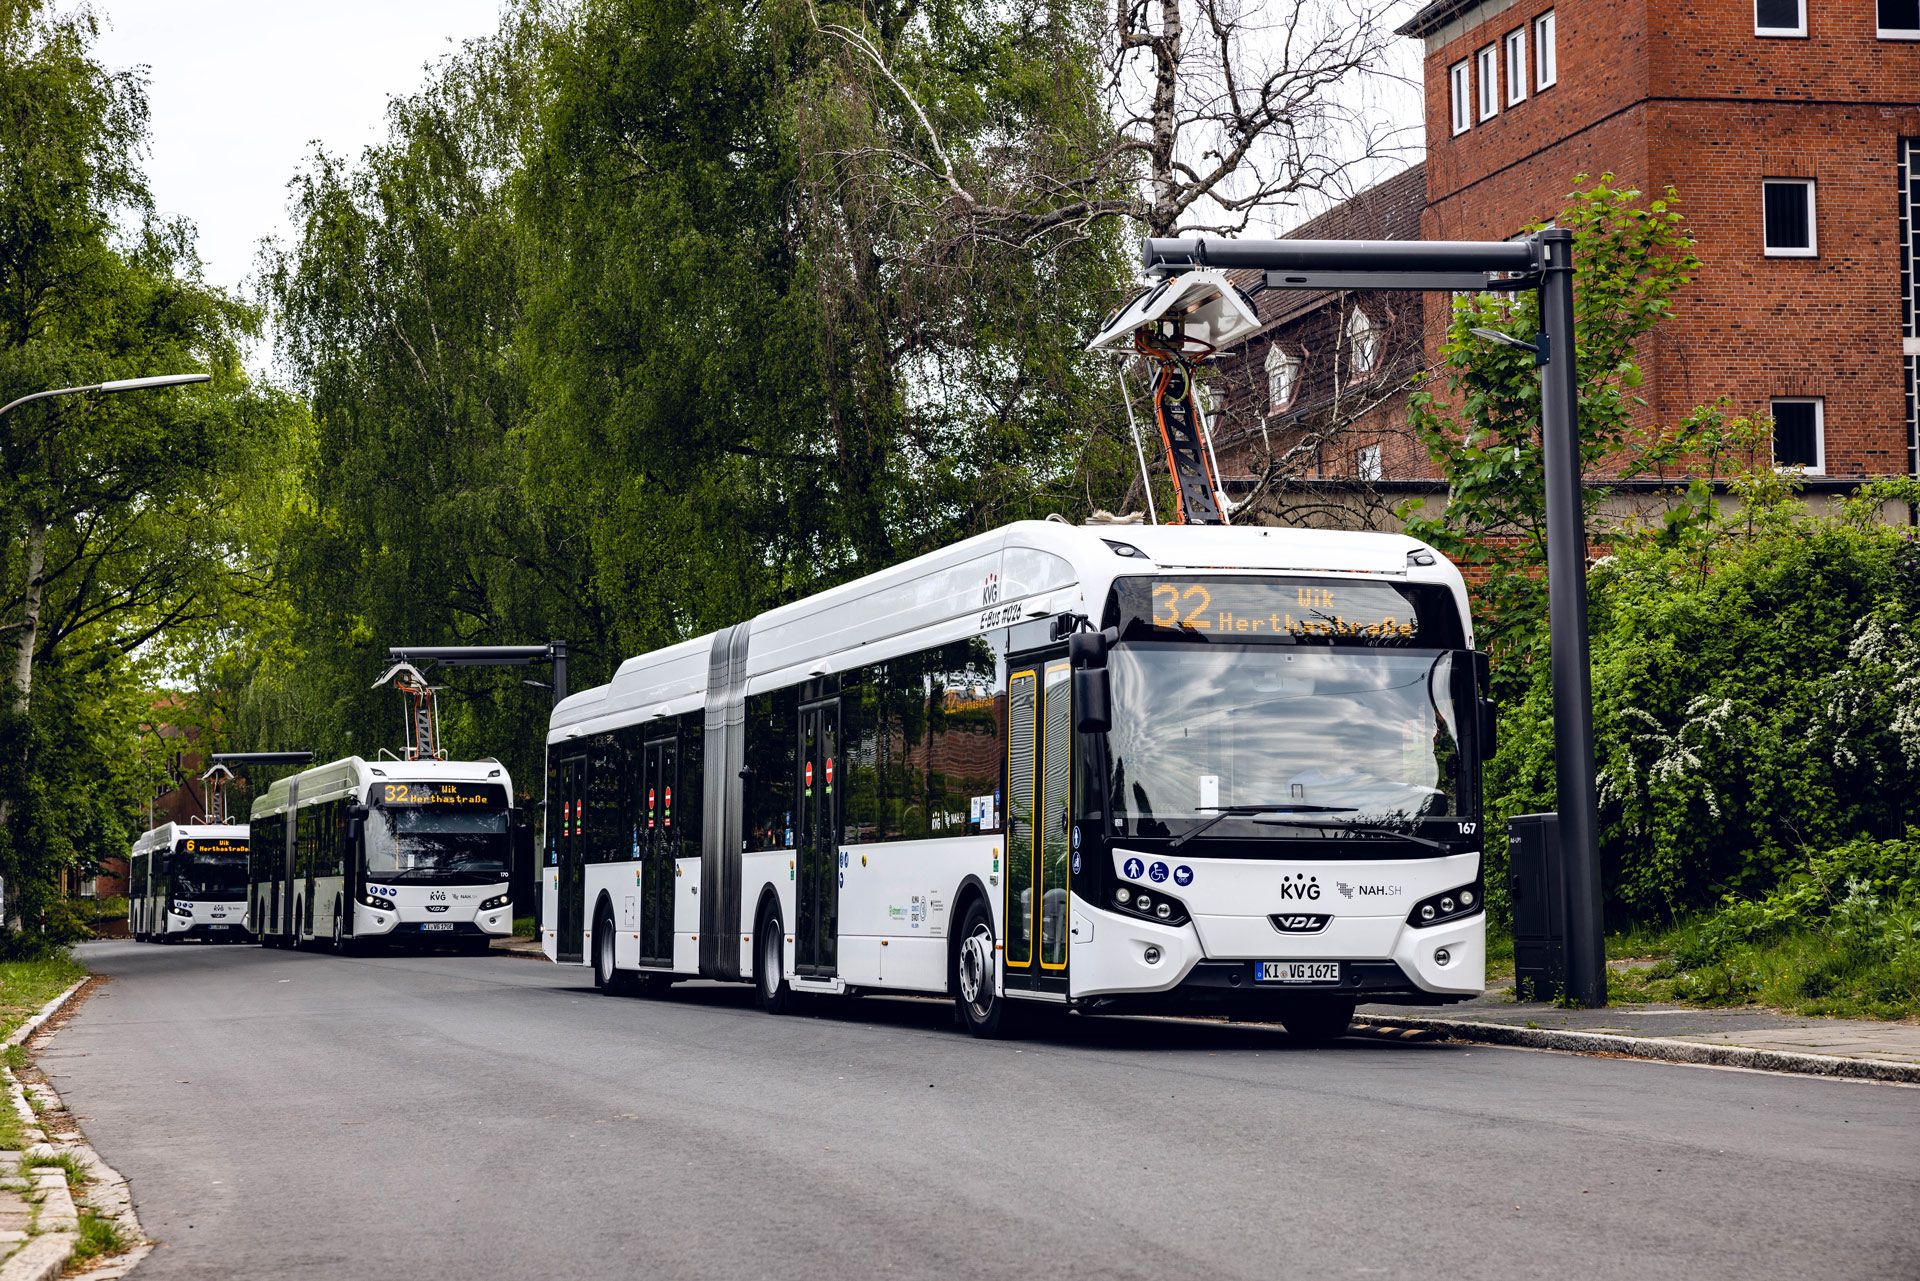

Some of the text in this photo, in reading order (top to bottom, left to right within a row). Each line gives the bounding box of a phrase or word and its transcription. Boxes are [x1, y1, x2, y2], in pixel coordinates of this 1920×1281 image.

[982, 584, 998, 606] KVG
[1298, 588, 1335, 608] Wik
[1152, 584, 1211, 628] 32
[1218, 612, 1416, 637] Herthastraße
[384, 785, 408, 802] 32
[441, 785, 457, 793] Wik
[410, 795, 487, 804] Herthastraße
[1457, 822, 1477, 834] 167
[187, 840, 195, 851] 6
[1281, 883, 1321, 900] KVG
[1359, 885, 1402, 896] NAH.SH
[1278, 916, 1321, 929] VDL
[1264, 964, 1338, 979] KI VG 167E
